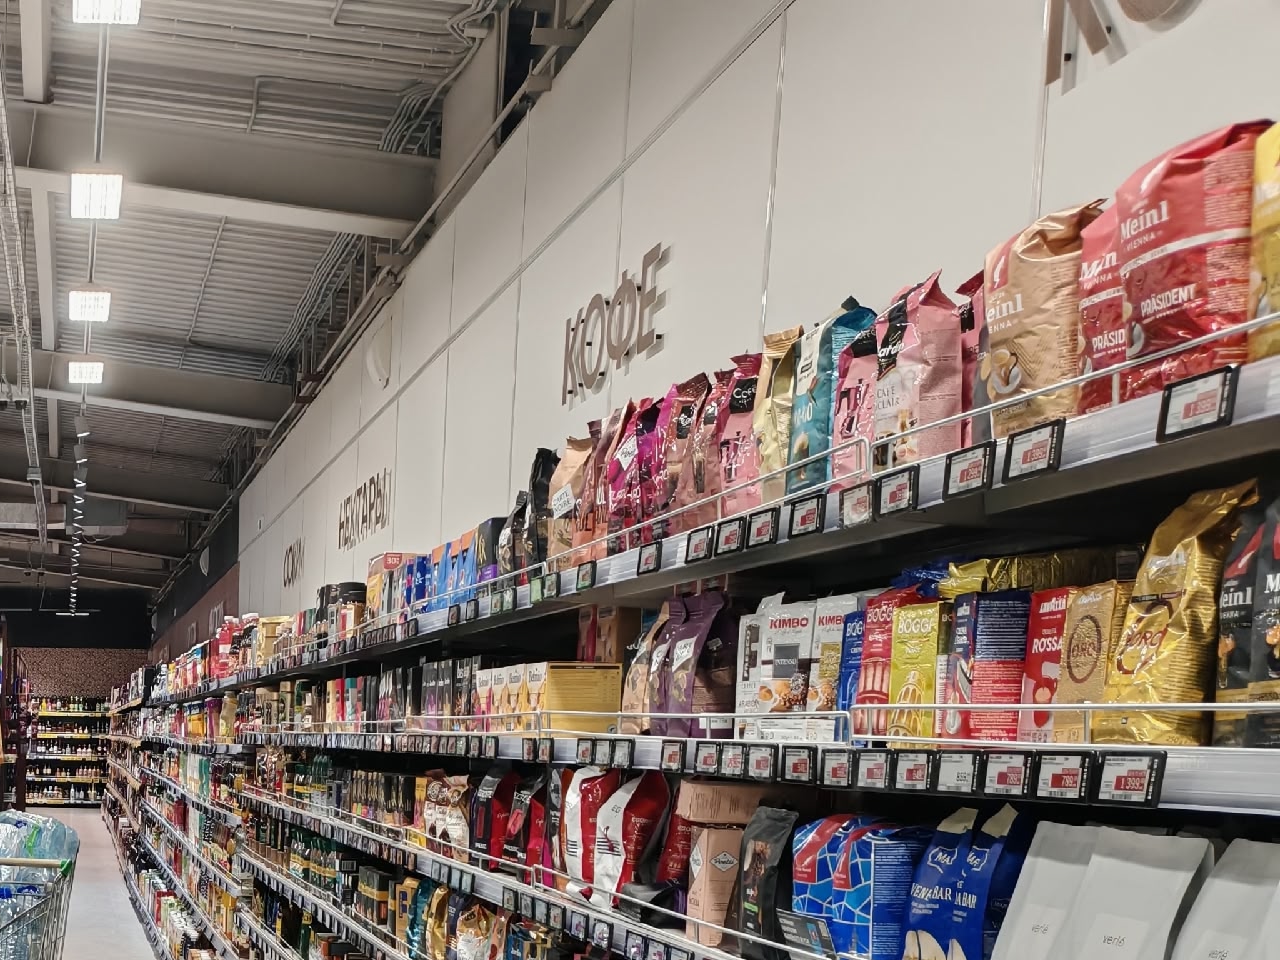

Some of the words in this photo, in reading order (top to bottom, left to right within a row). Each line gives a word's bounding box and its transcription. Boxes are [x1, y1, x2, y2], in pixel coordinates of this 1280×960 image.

[986, 293, 1024, 323] einl
[1140, 283, 1198, 317] PRÄSIDENT
[561, 241, 666, 407] КОФЕ
[1092, 328, 1126, 352] PRÄSID
[770, 616, 809, 629] KIMBO
